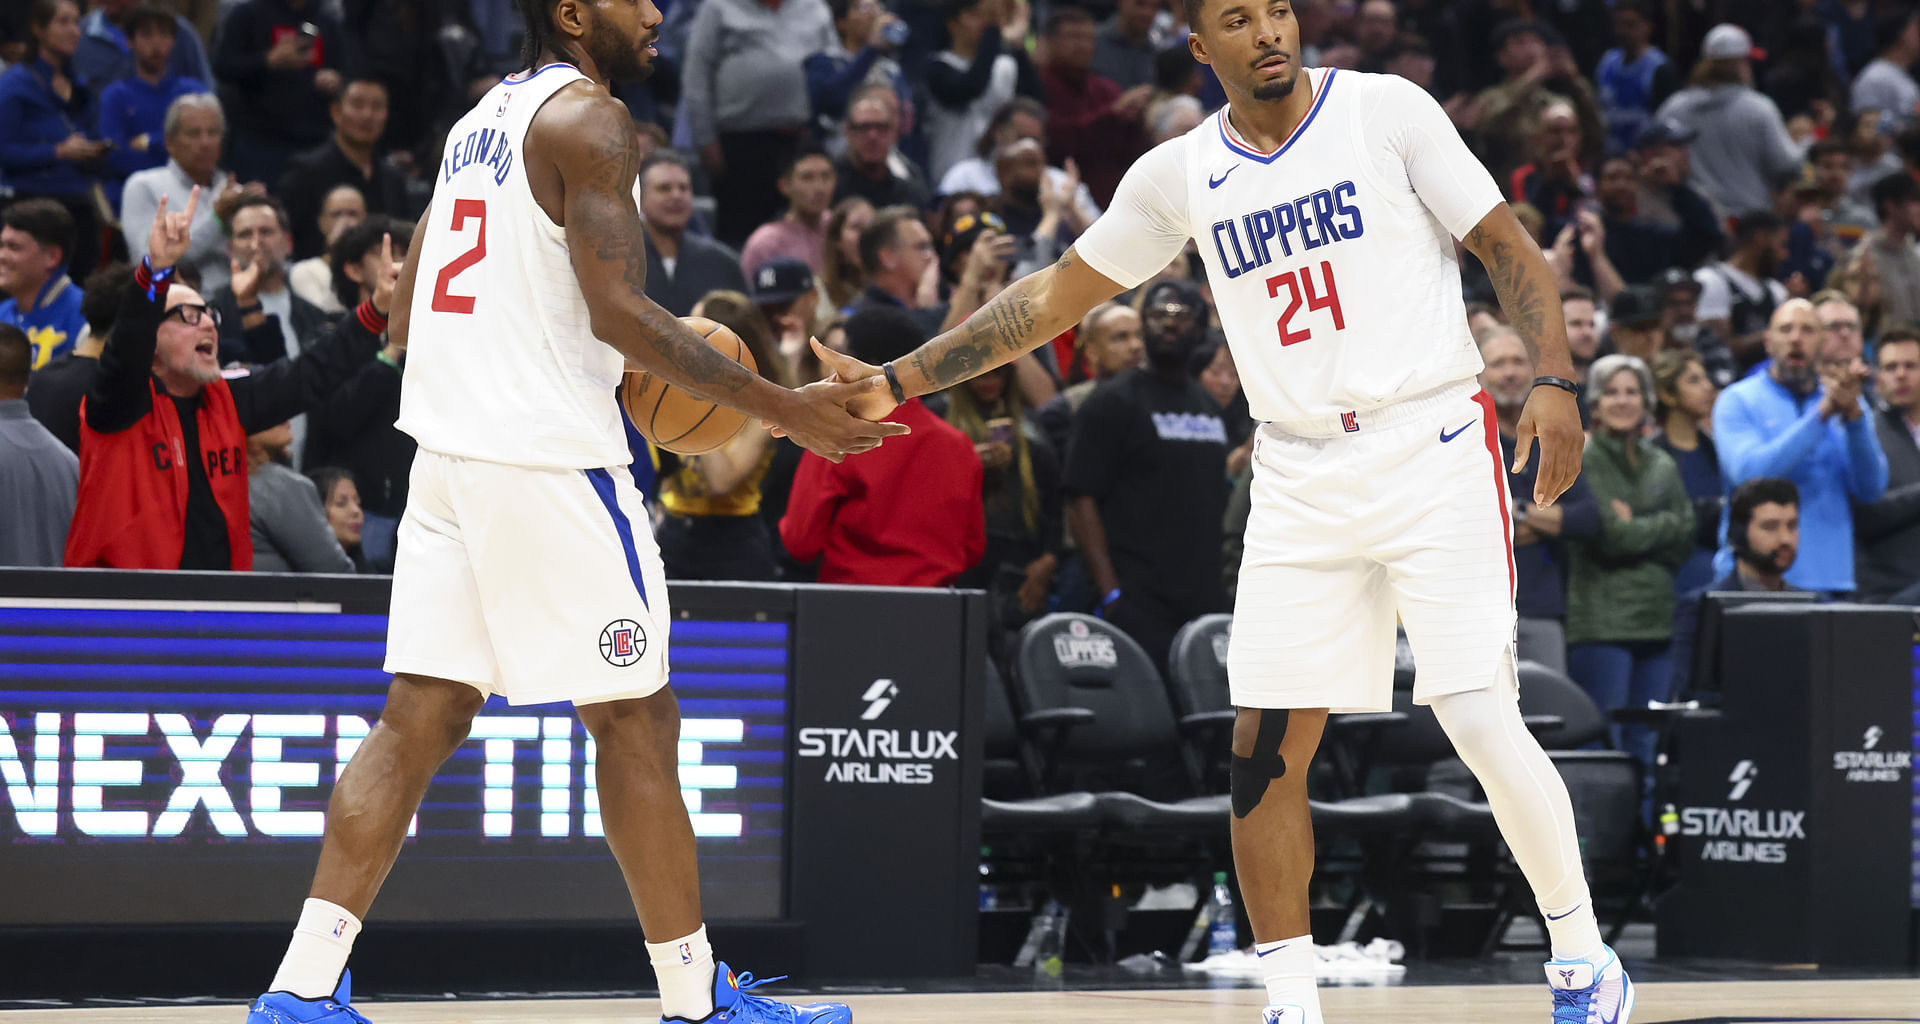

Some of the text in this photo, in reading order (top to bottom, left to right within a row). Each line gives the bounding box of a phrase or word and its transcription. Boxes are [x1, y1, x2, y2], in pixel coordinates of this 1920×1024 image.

[1211, 180, 1364, 279] CLIPPERS
[431, 198, 487, 314] 2
[1265, 260, 1345, 347] 24
[798, 728, 959, 760] STARLUX
[824, 761, 933, 784] AIRLINES
[1833, 751, 1912, 770] STARLUX
[1681, 807, 1806, 839] STARLUX
[1701, 841, 1787, 863] AIRLINES
